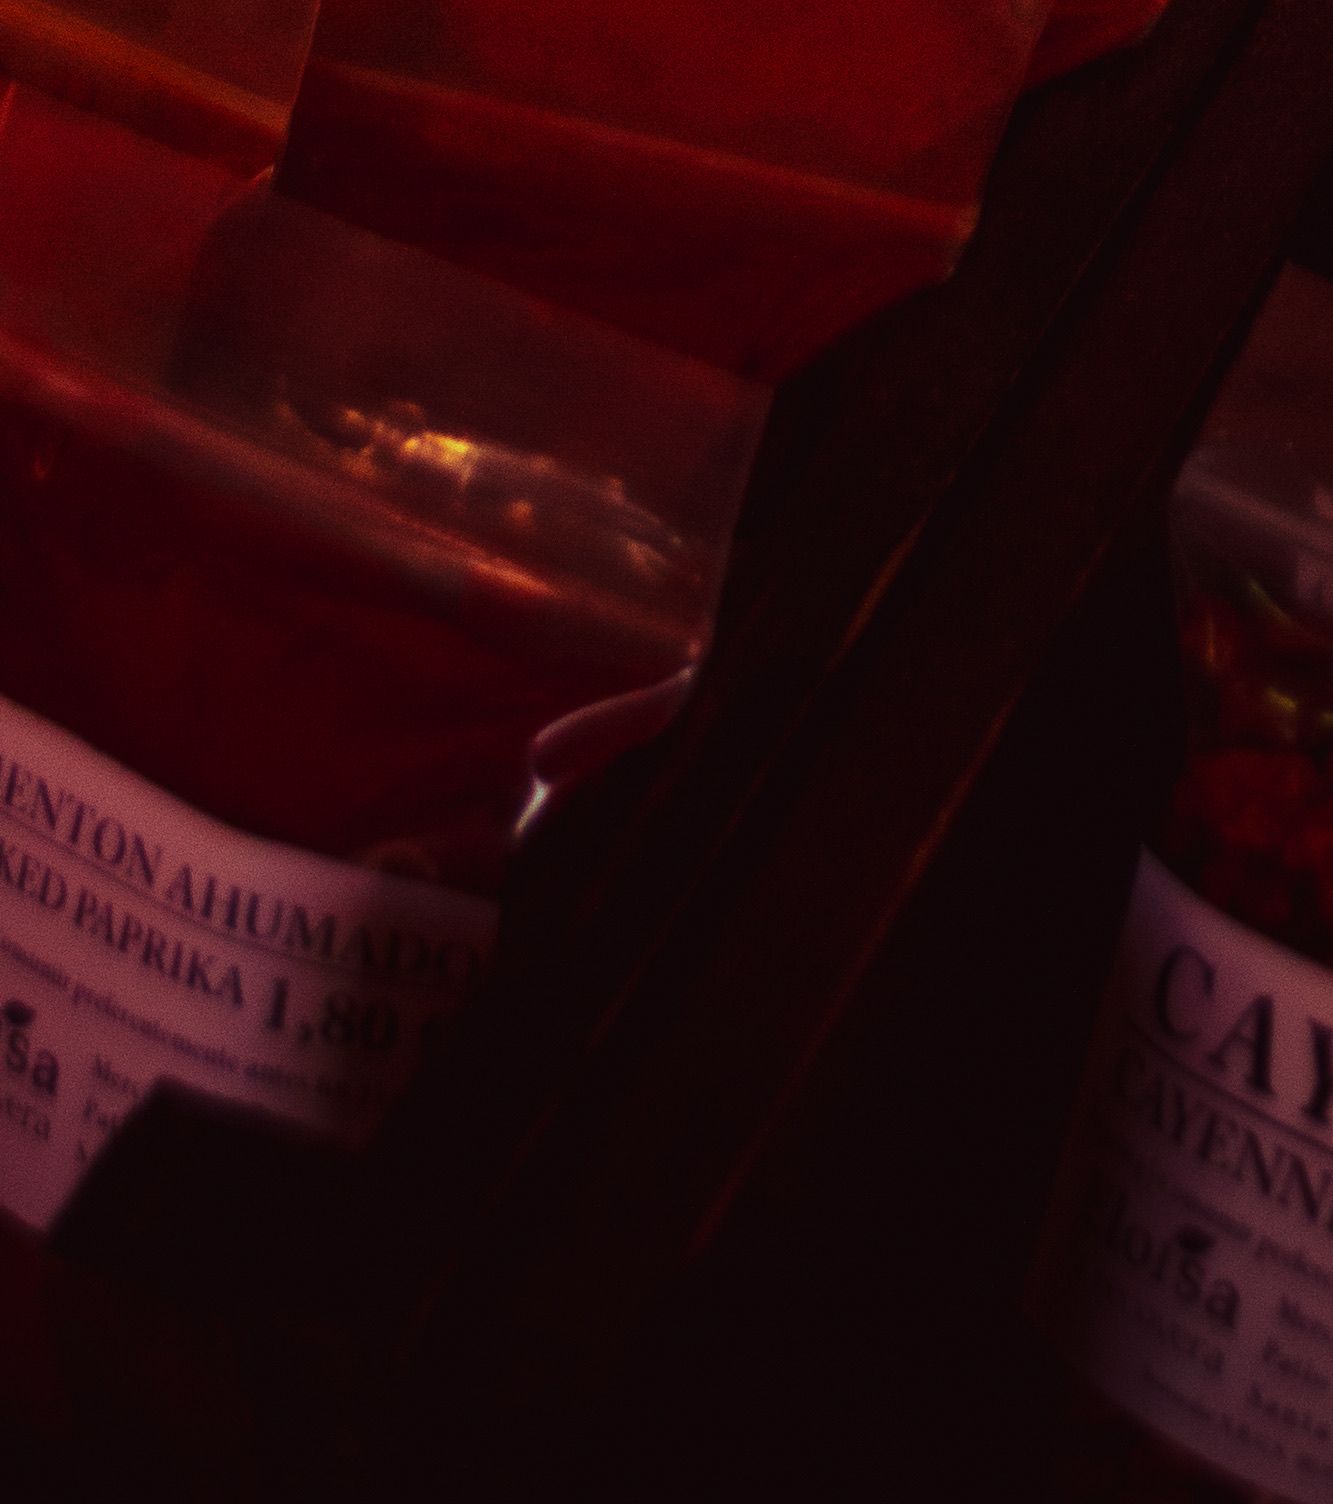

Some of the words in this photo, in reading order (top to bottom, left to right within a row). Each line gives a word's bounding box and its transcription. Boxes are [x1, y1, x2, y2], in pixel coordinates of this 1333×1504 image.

[73, 888, 244, 1009] PAPRIKA
[265, 976, 399, 1053] 1,80
[165, 864, 480, 981] AHUMADO
